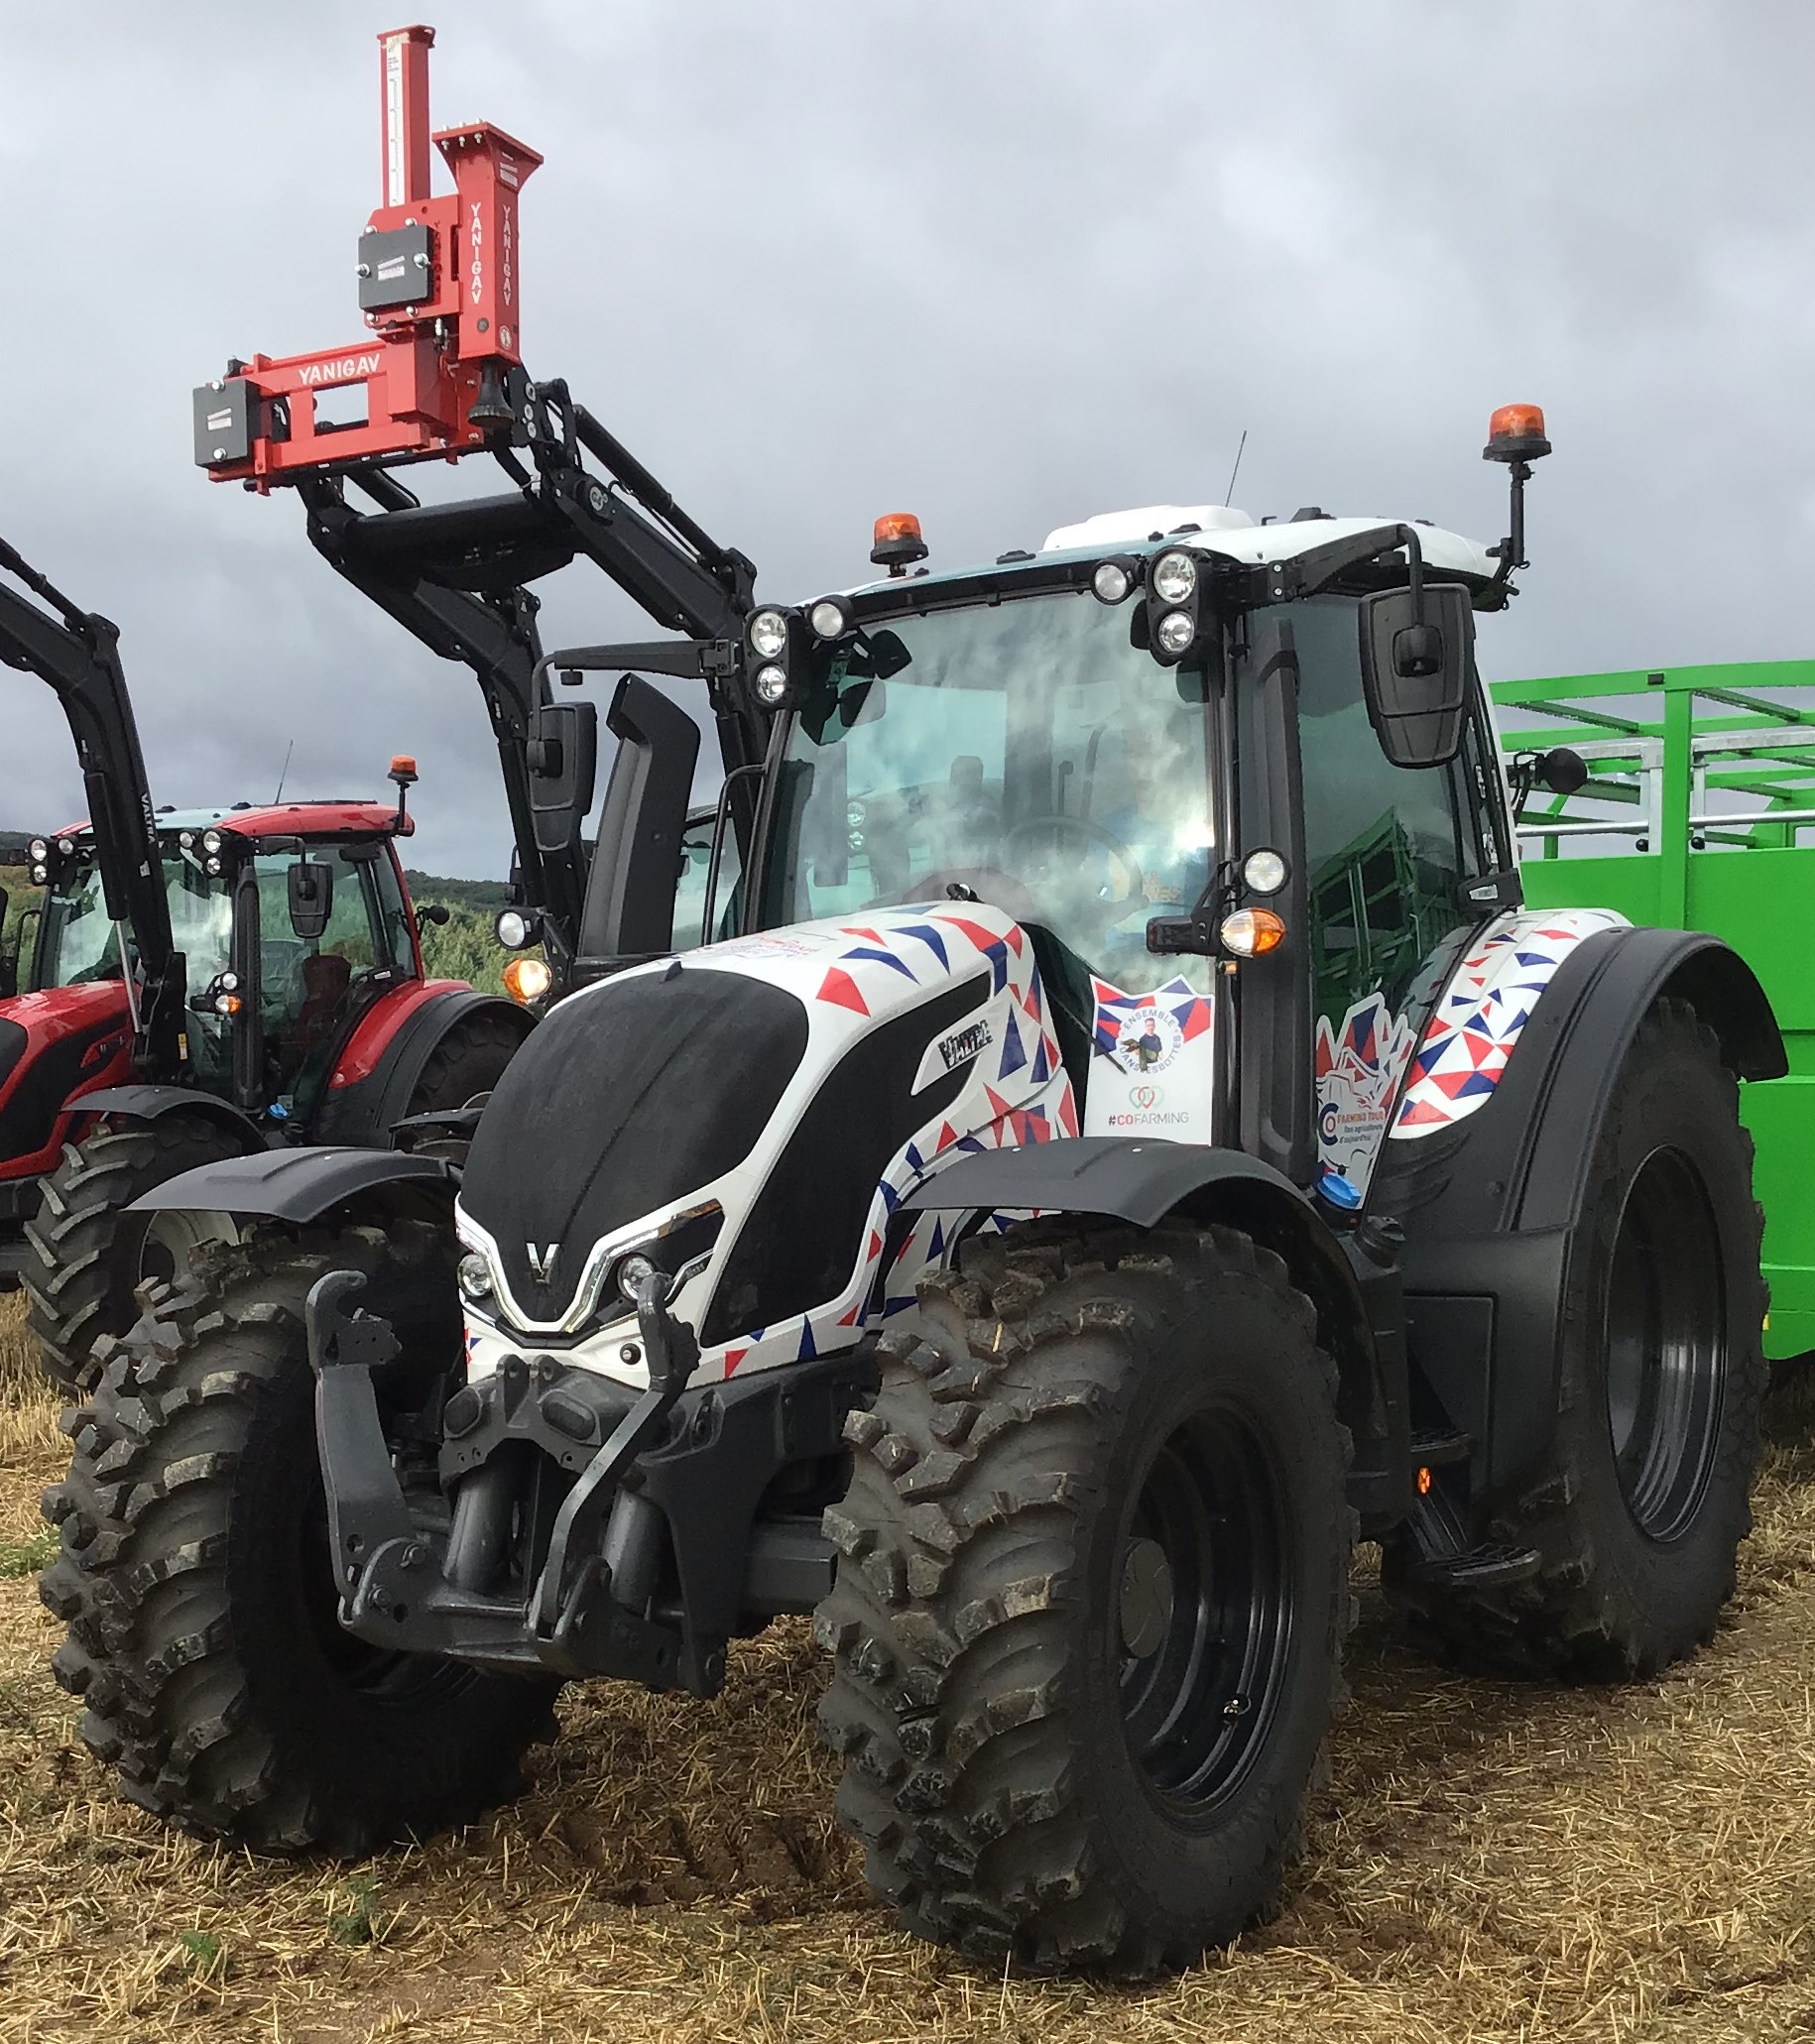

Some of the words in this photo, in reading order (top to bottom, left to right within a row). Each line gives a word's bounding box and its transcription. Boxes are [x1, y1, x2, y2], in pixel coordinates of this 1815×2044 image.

[470, 201, 483, 304] YANIGAV
[503, 203, 512, 306] YANIGAV
[299, 353, 381, 386] YANIGAV
[1123, 1009, 1176, 1030] ENSEMBLE
[1108, 1112, 1189, 1127] #COFARMING
[1337, 1112, 1367, 1124] FARMING
[1368, 1111, 1384, 1121] TOUR
